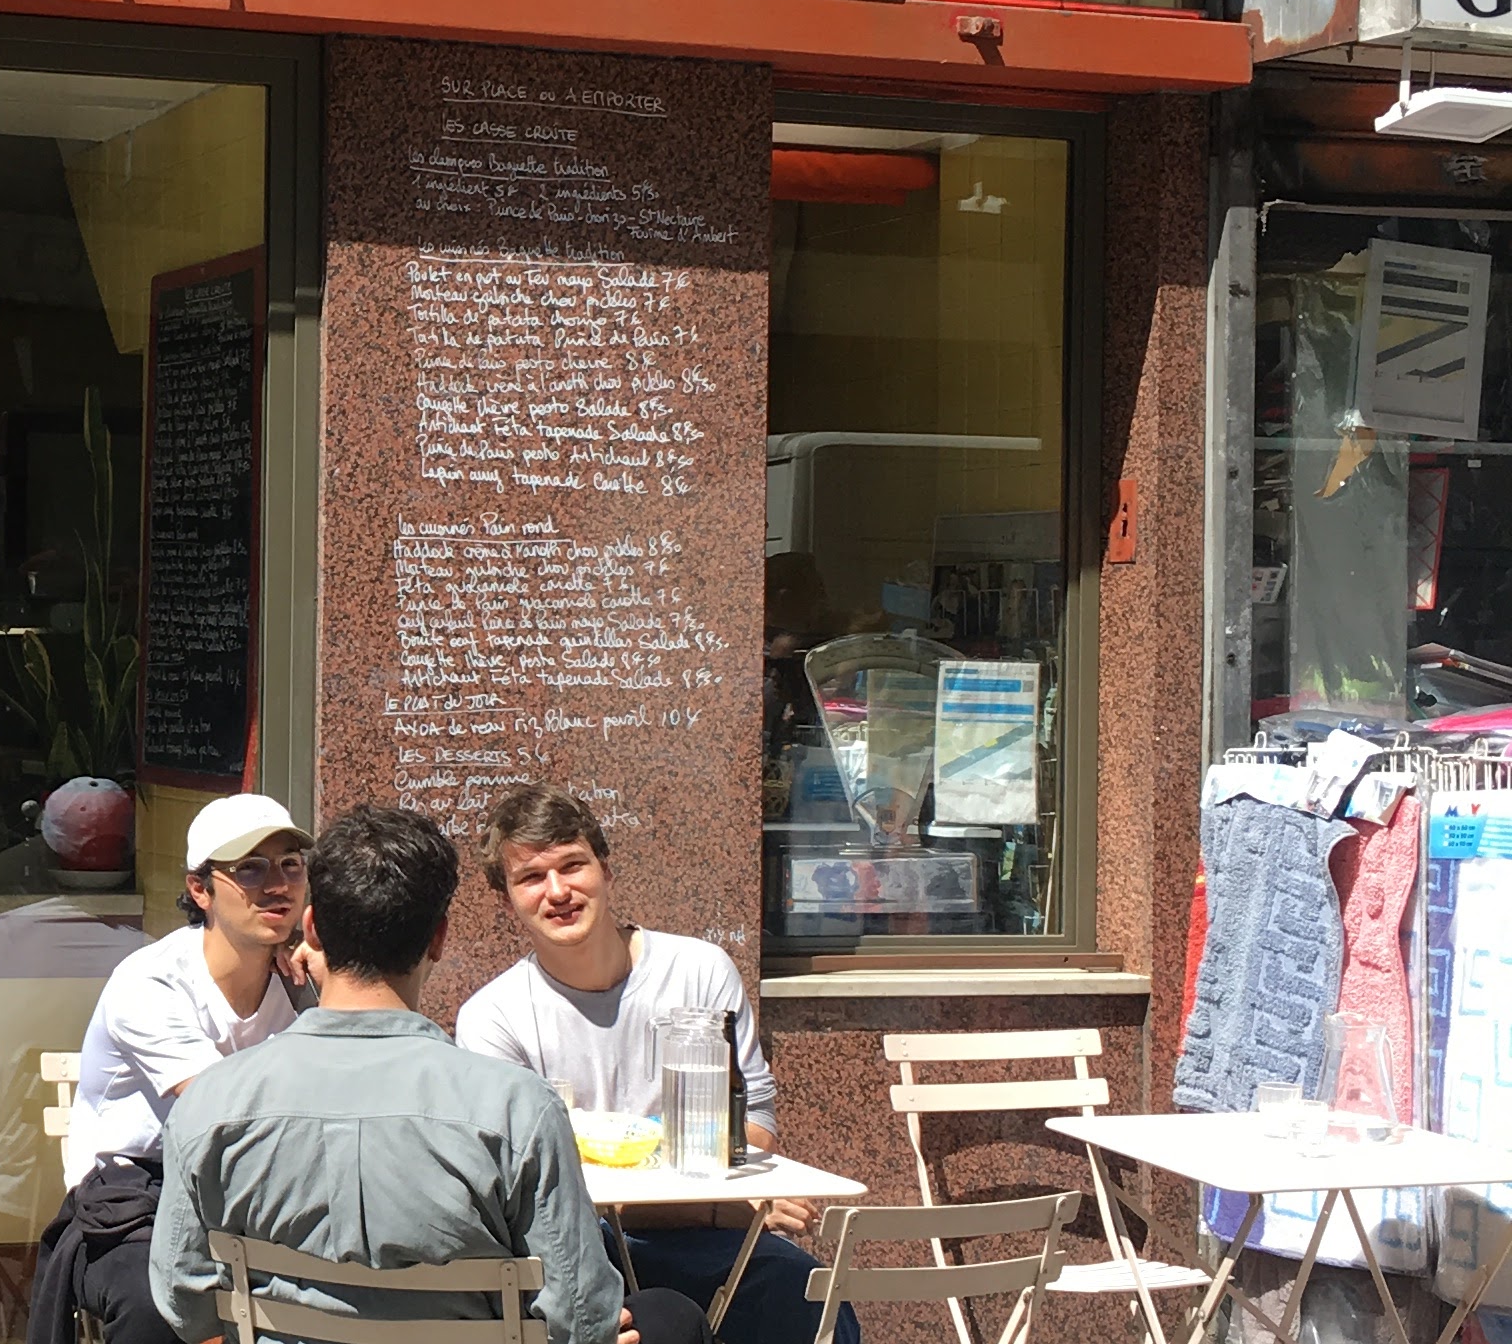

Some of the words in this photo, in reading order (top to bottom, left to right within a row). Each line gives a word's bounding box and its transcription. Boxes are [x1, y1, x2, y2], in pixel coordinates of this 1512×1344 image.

[441, 75, 475, 96] SUR
[481, 80, 528, 99] PLACE
[582, 90, 666, 112] EMPORTER
[472, 120, 519, 138] CASSE
[553, 156, 609, 178] tradition
[564, 240, 625, 262] tradition
[434, 745, 512, 765] DESSERTS
